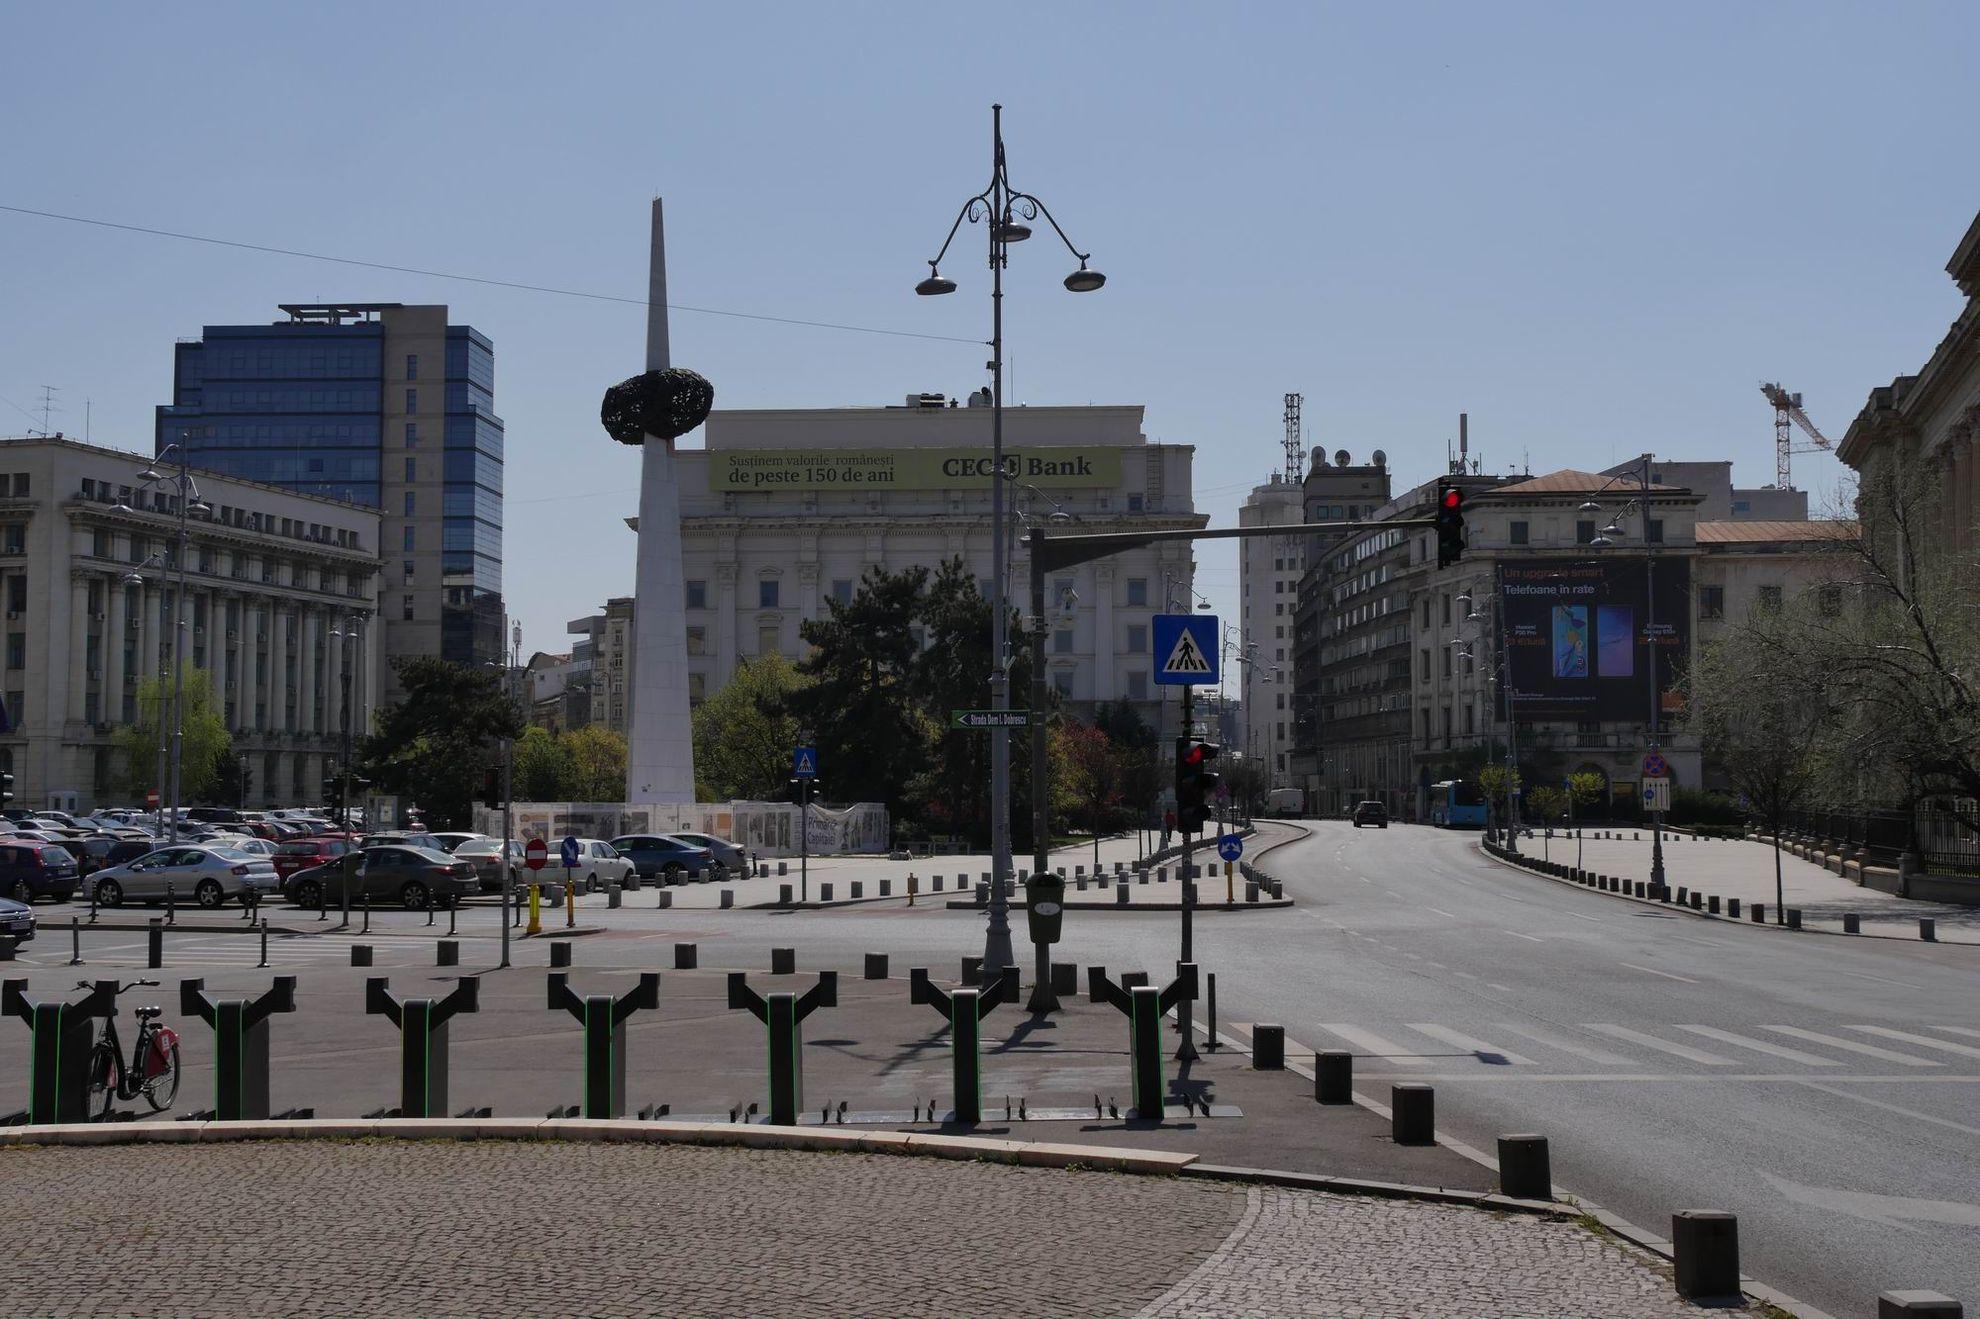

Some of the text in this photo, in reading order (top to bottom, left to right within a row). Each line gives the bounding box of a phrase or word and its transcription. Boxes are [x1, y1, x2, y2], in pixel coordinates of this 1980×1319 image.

[787, 454, 830, 466] valorile
[943, 456, 1092, 477] CEC Bank
[729, 467, 895, 487] de peste 150 de ani
[1504, 568, 1520, 577] Un
[1571, 567, 1604, 578] smart
[1504, 584, 1595, 595] Telefoane în rate
[970, 713, 986, 725] Strada
[987, 713, 999, 725] Dem
[1004, 713, 1027, 725] Dobrescu
